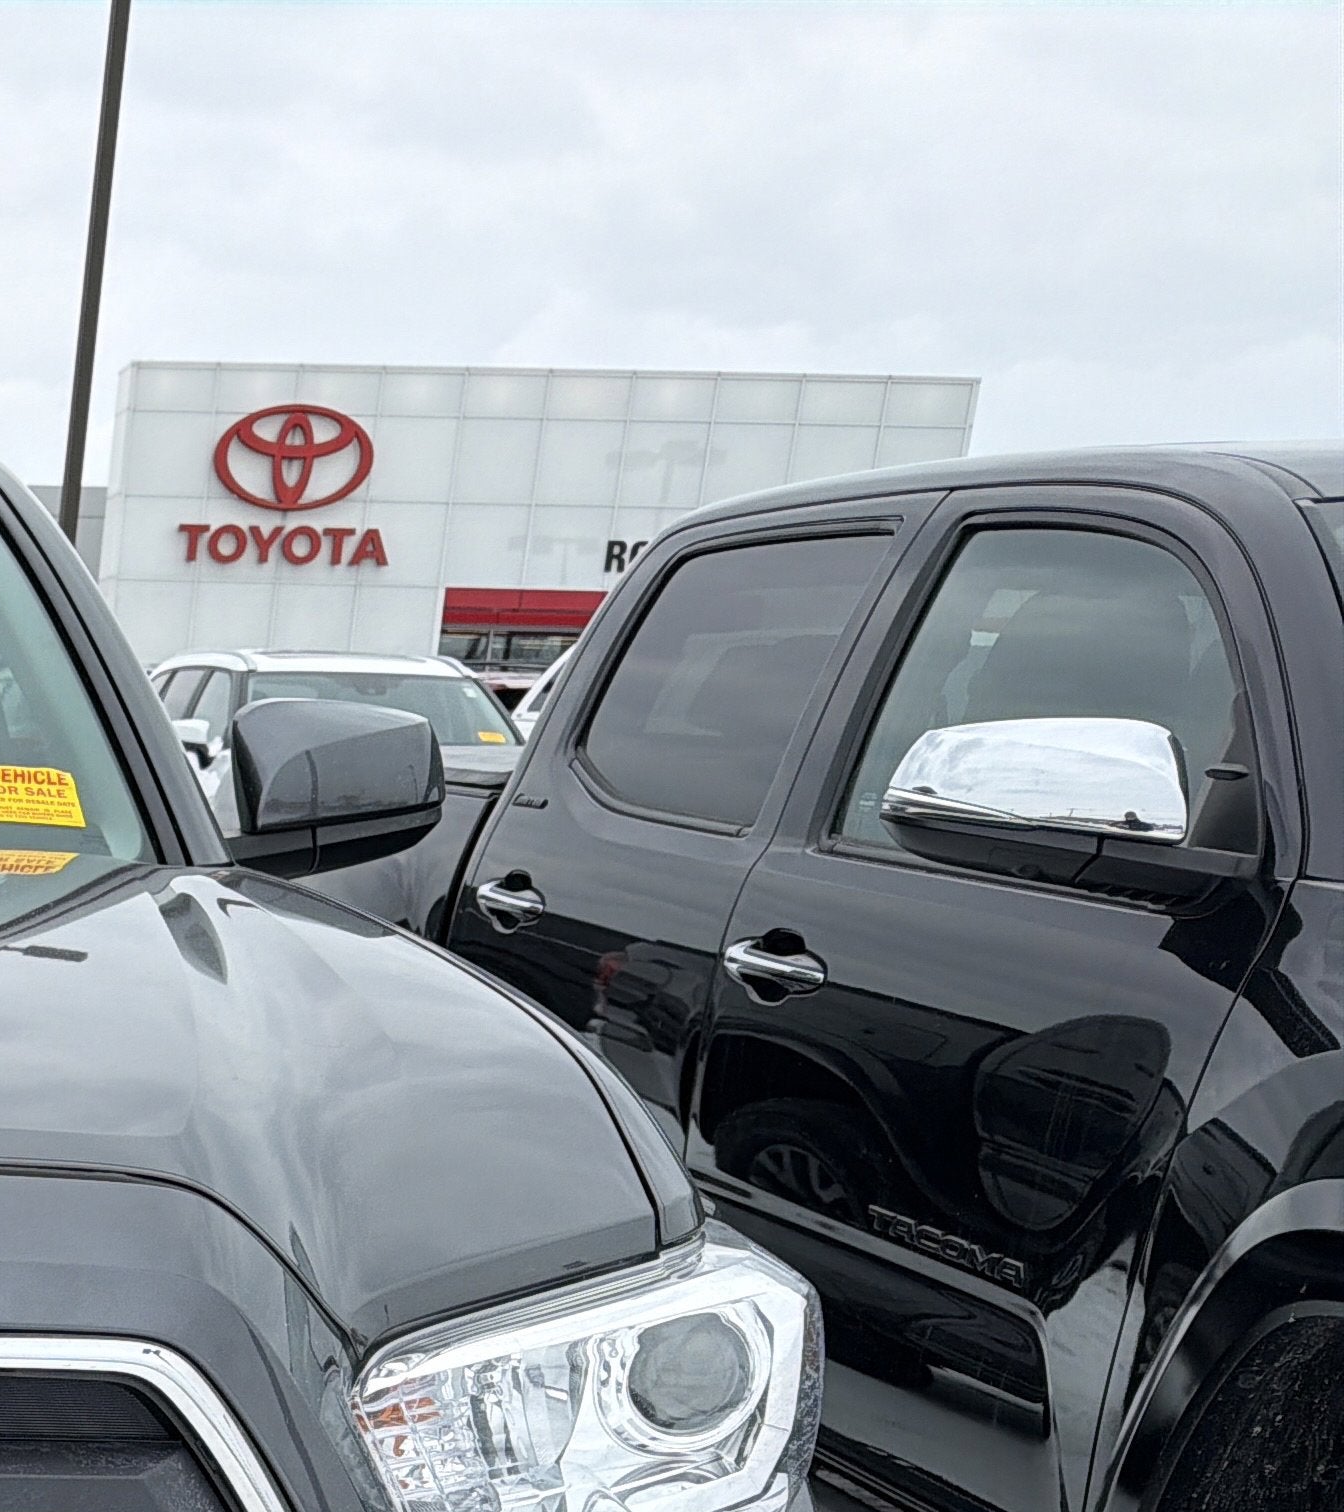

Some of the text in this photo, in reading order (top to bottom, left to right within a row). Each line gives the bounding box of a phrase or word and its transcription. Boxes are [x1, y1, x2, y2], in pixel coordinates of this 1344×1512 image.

[179, 523, 389, 567] TOYOTA
[24, 787, 68, 799] SALE
[868, 1203, 1026, 1289] TACOMA
